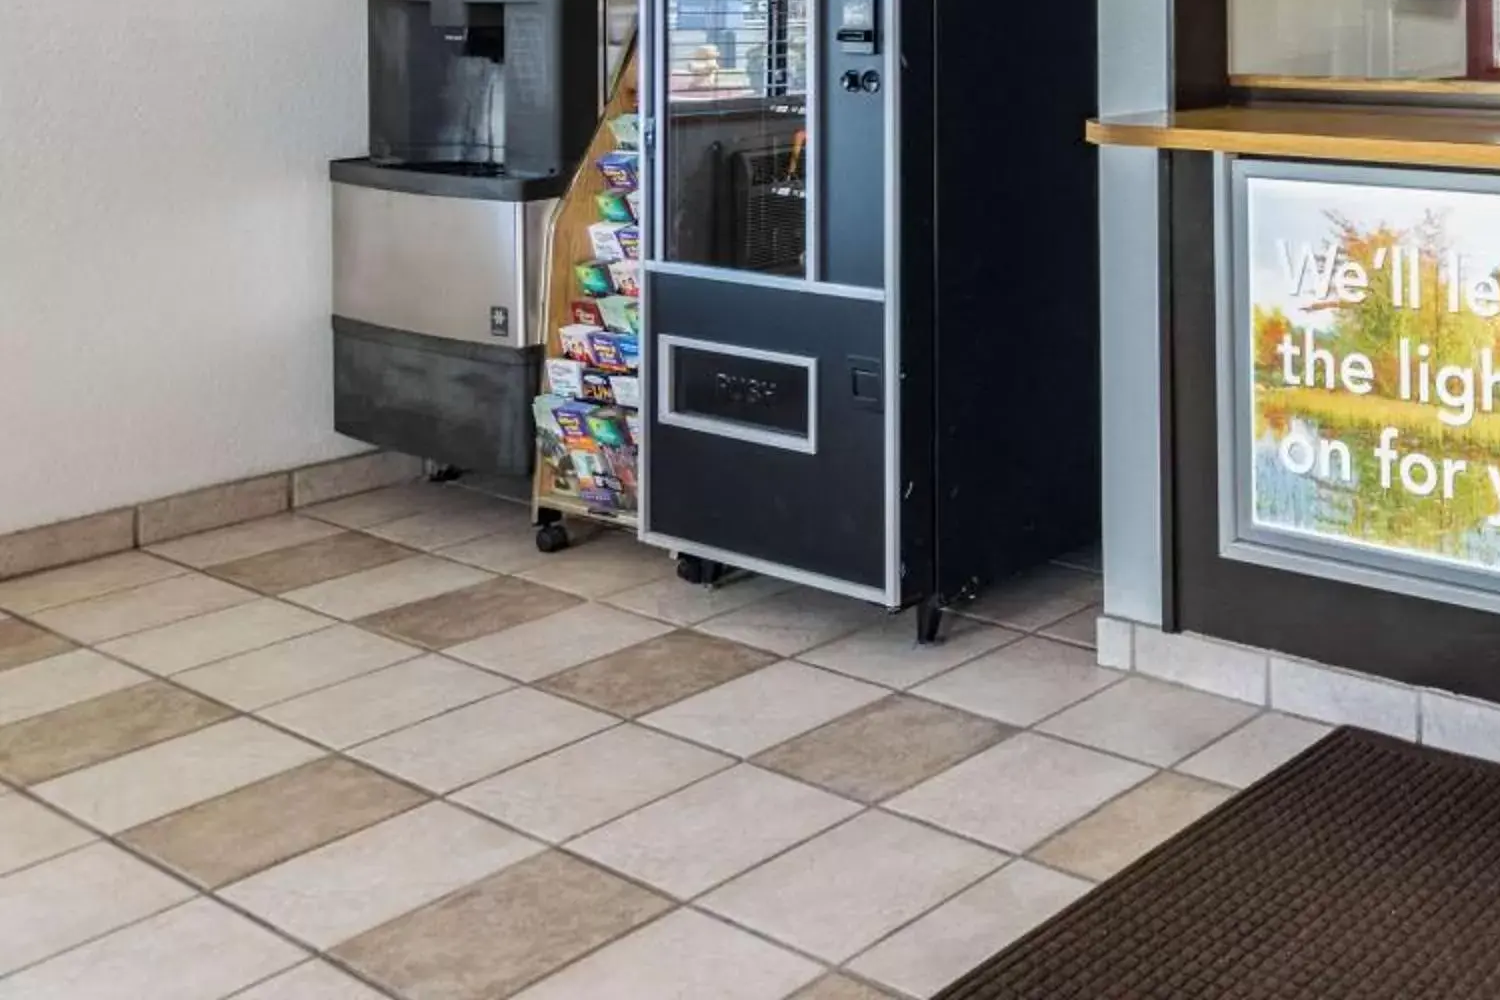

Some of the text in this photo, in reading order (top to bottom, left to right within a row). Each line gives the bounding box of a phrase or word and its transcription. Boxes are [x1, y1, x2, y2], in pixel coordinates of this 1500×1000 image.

[1277, 332, 1374, 394] the
[1279, 428, 1352, 483] on
[1374, 426, 1467, 501] for
